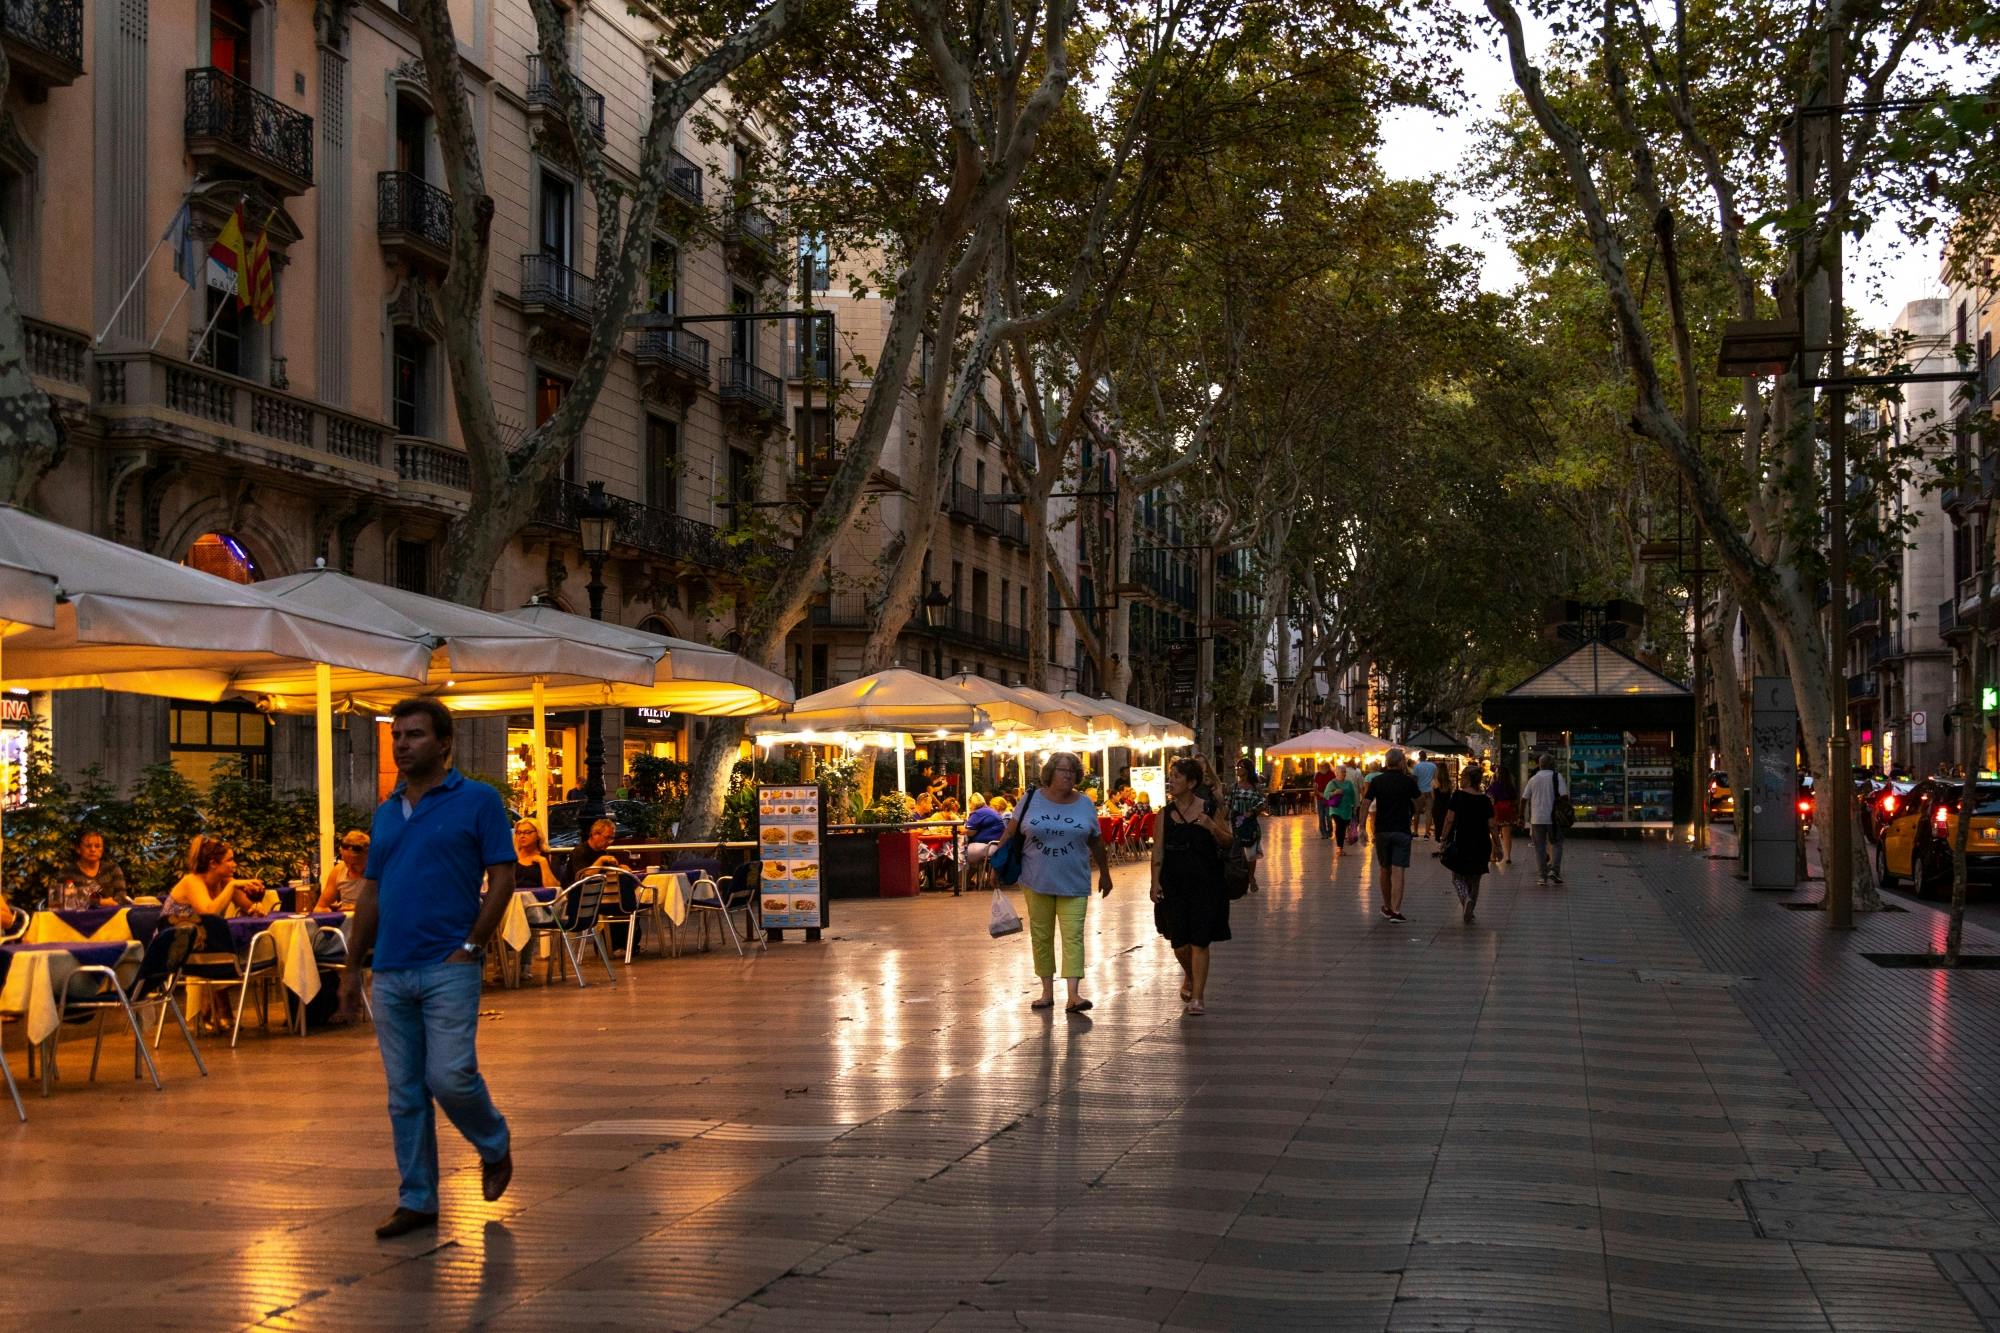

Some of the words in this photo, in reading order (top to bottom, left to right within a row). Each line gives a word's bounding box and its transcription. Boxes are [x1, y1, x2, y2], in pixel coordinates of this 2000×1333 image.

[638, 707, 671, 719] PRIETO
[1030, 814, 1084, 831] ENJOY
[1045, 828, 1065, 836] THE
[1031, 836, 1075, 857] MOMENT
